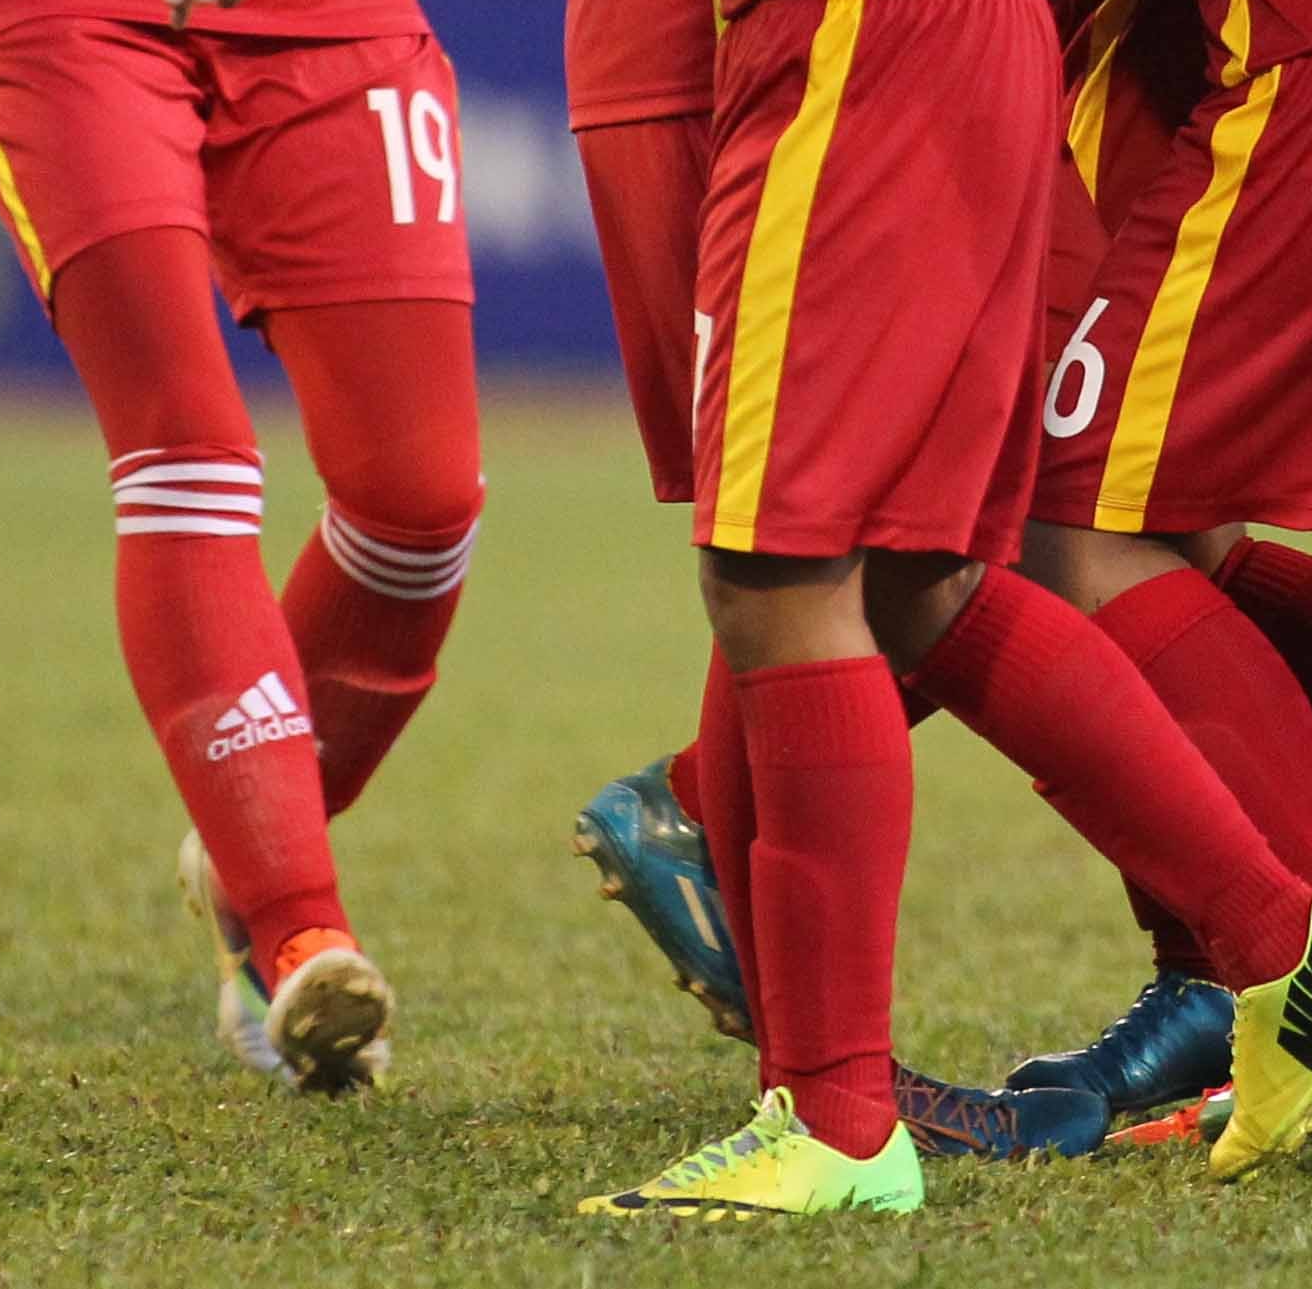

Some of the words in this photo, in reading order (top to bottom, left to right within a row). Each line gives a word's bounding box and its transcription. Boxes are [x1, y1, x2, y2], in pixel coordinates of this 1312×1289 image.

[367, 88, 455, 223] 19
[1043, 297, 1109, 438] 6
[207, 715, 311, 762] adidas
